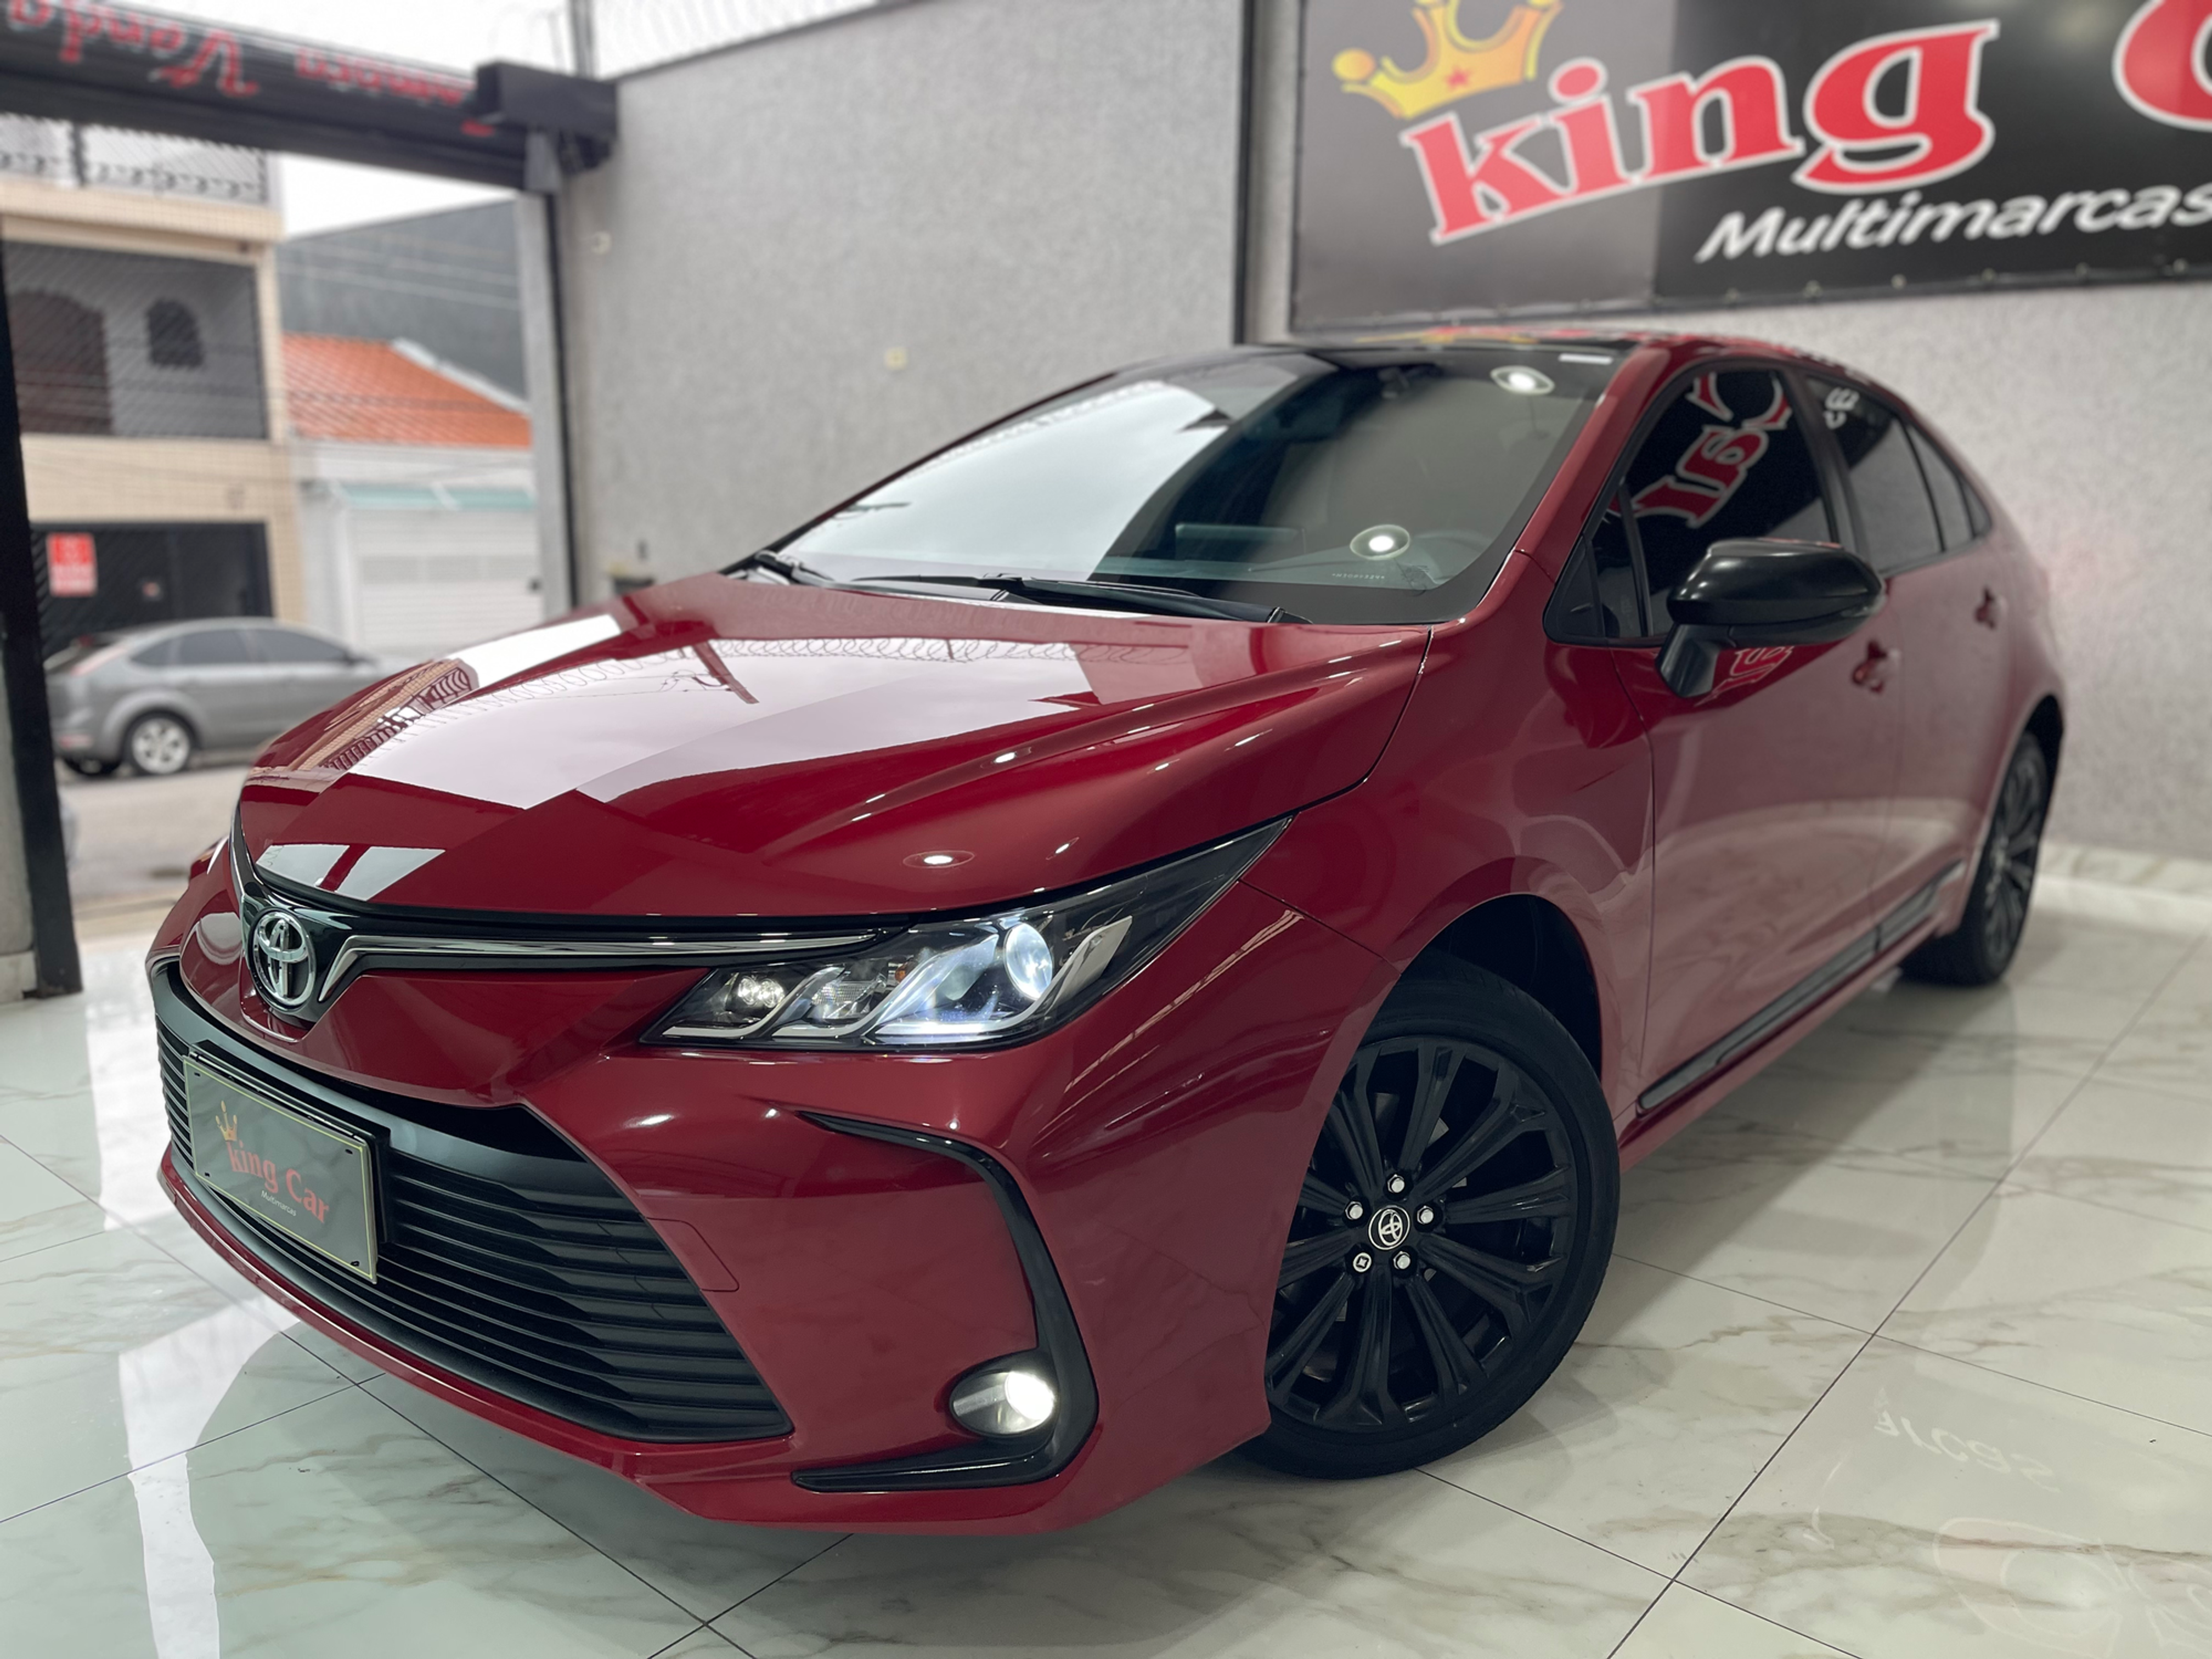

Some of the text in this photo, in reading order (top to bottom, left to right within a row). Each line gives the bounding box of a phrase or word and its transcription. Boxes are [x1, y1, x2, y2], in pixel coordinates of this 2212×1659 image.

[1398, 18, 2000, 246] king
[1695, 183, 2212, 262] Multimarcas
[227, 1139, 329, 1224] king Car
[261, 1189, 297, 1217] Multimarcas
